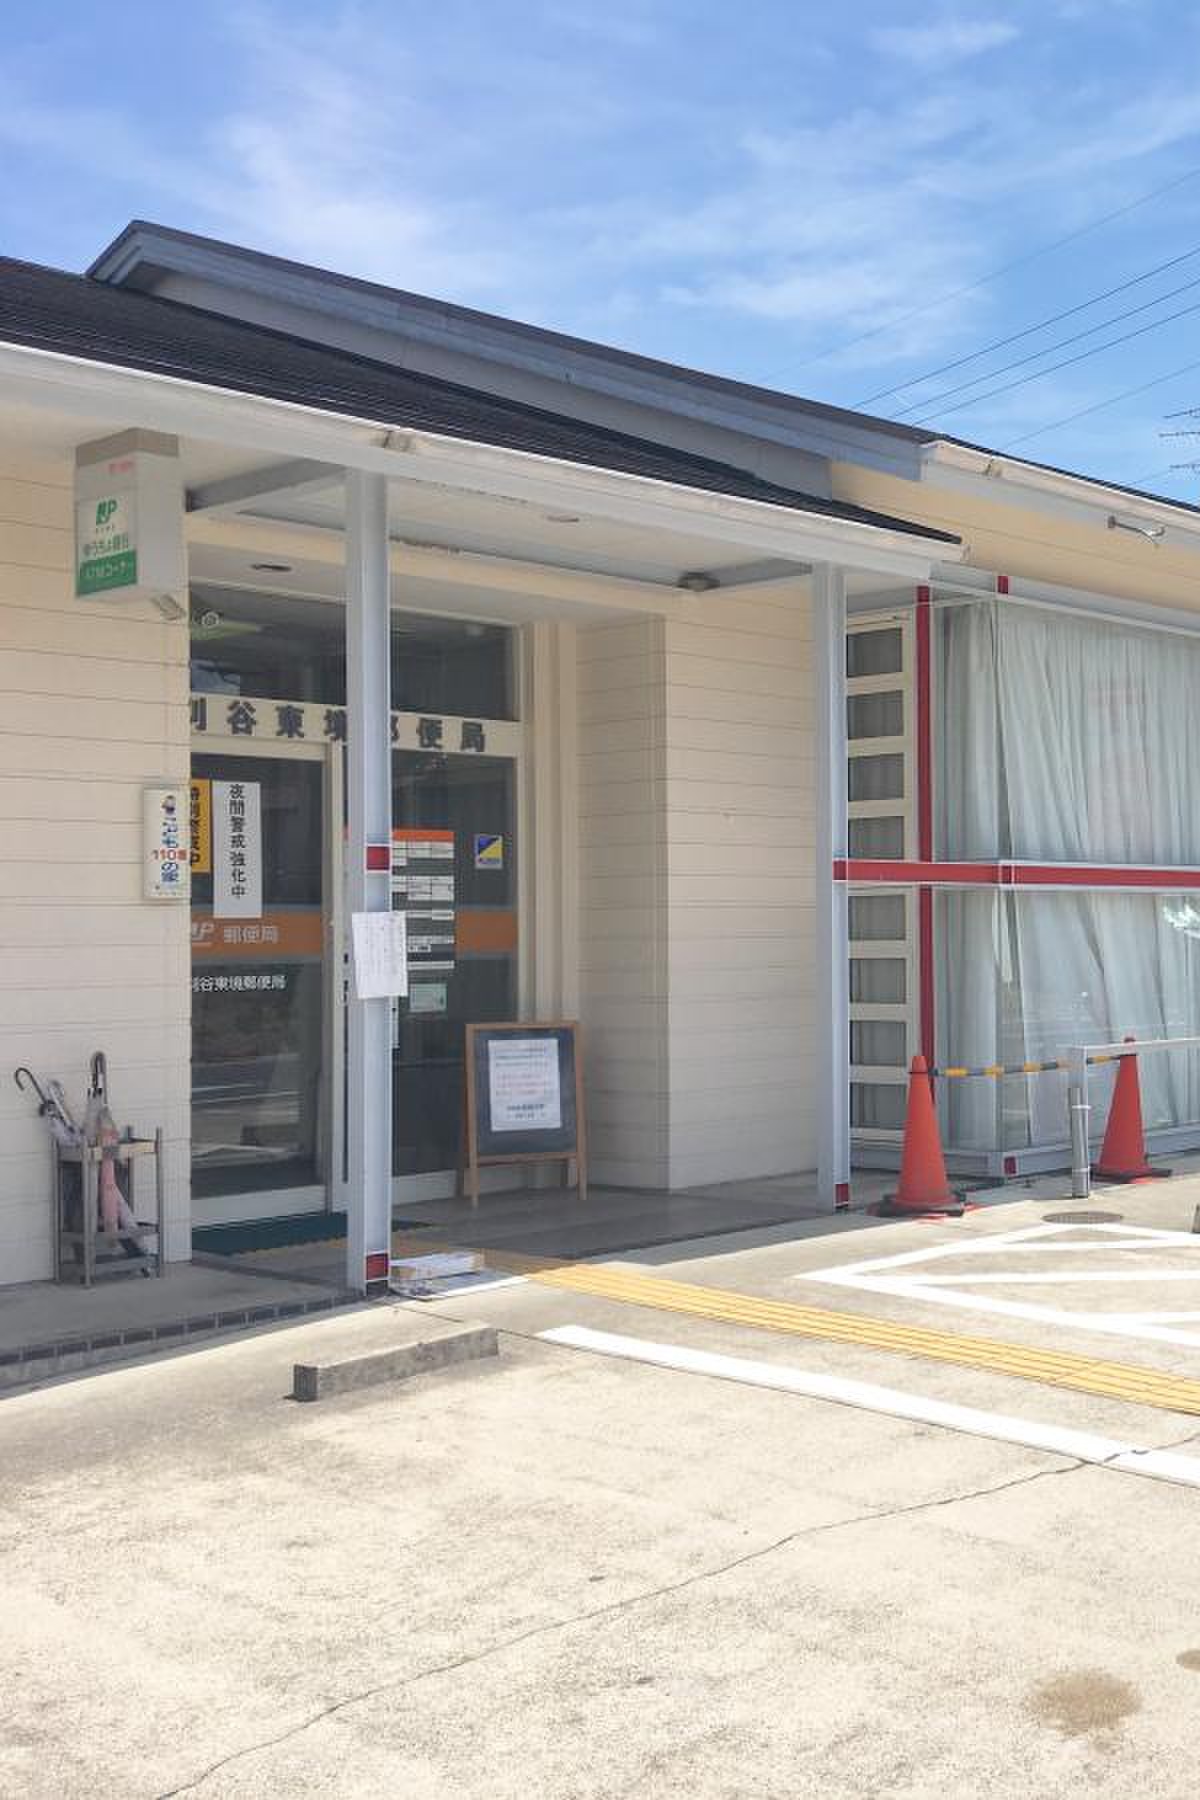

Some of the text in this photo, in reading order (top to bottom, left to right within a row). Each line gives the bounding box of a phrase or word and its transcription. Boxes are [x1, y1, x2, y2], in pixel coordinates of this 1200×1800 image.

[191, 697, 485, 752] 谷東境便局
[230, 784, 246, 899] 夜間警戒強化中
